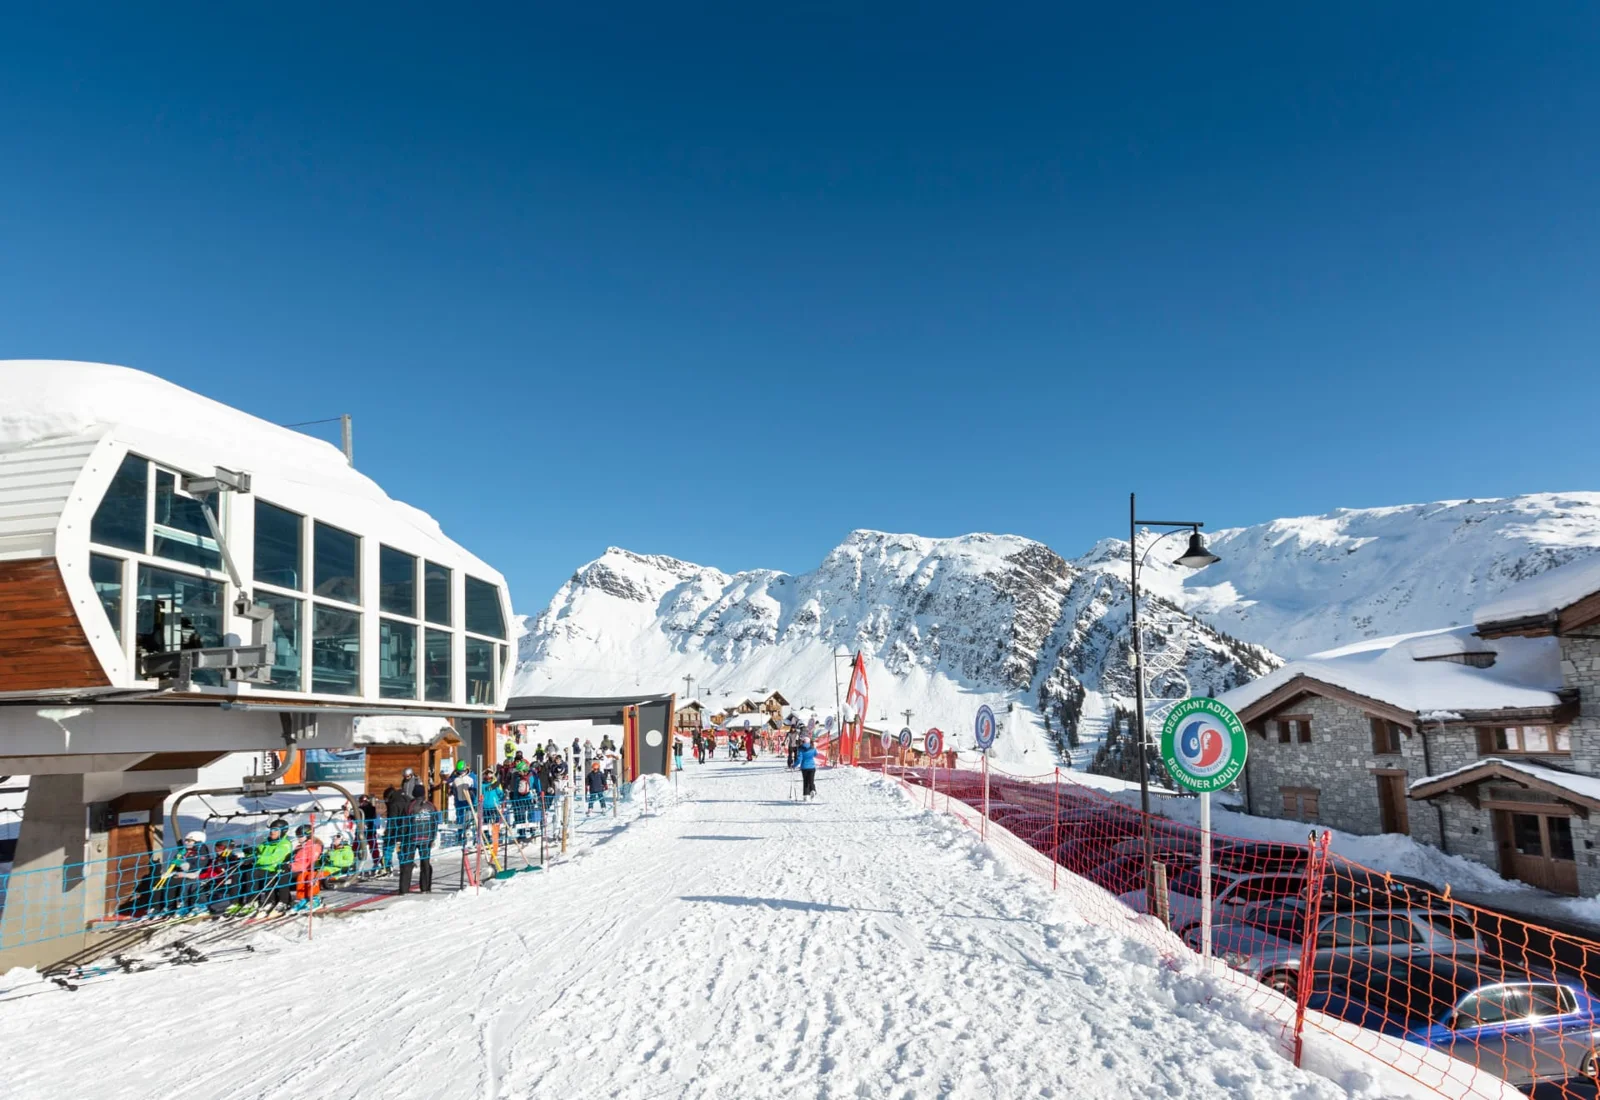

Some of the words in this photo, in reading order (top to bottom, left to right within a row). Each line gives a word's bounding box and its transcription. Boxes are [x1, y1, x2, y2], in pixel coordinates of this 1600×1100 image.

[1165, 700, 1205, 734] DEBUTANT
[1207, 702, 1241, 734] ADULTE
[1167, 757, 1211, 788] BEGINNER
[1213, 759, 1239, 787] ADULT
